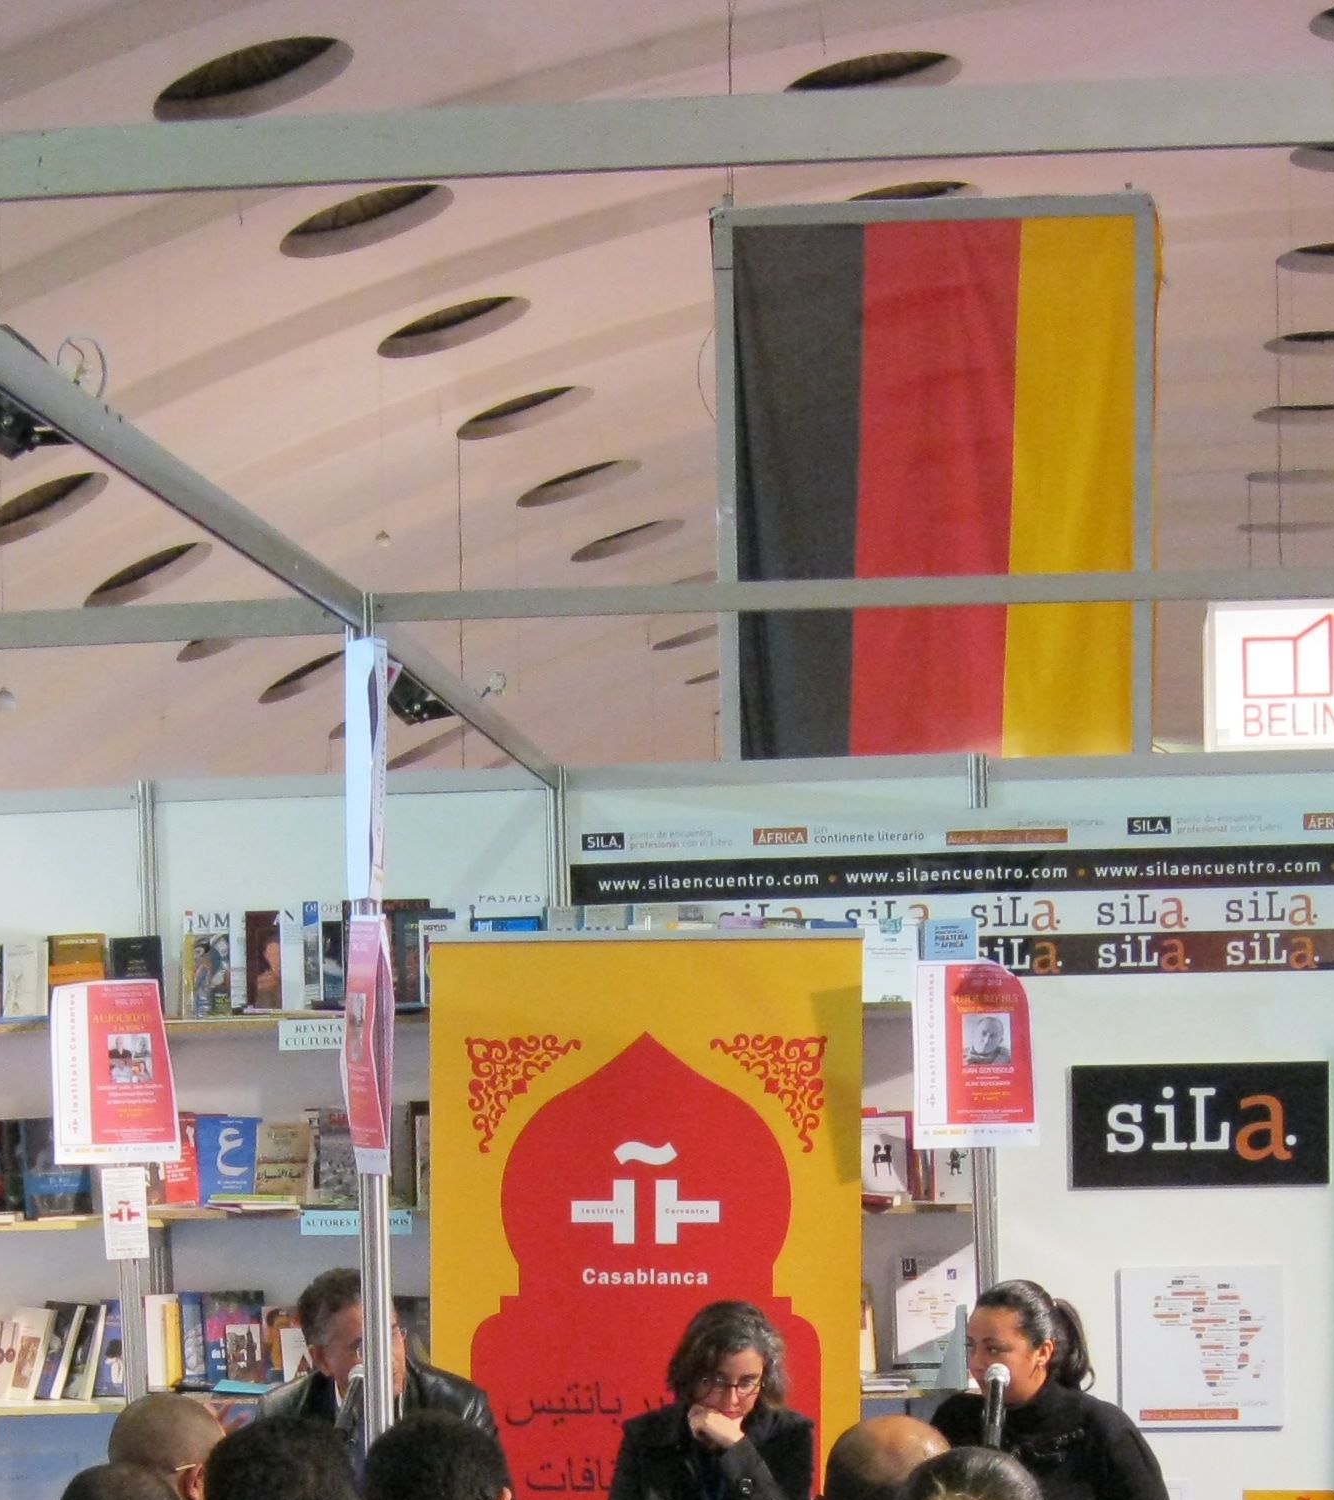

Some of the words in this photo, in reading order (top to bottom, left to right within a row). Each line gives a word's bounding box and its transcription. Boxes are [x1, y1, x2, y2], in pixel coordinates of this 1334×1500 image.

[1133, 820, 1168, 833] SILA,
[757, 828, 805, 845] ÁFRICA
[814, 833, 874, 844] continente
[878, 831, 924, 842] literario
[598, 872, 819, 892] www.silaencuentro.com
[845, 866, 1068, 884] www.silaencuentro.com
[1094, 860, 1321, 878] www.silaencuentro.com
[664, 1207, 710, 1215] Cervantes
[582, 1267, 709, 1285] Casablanca
